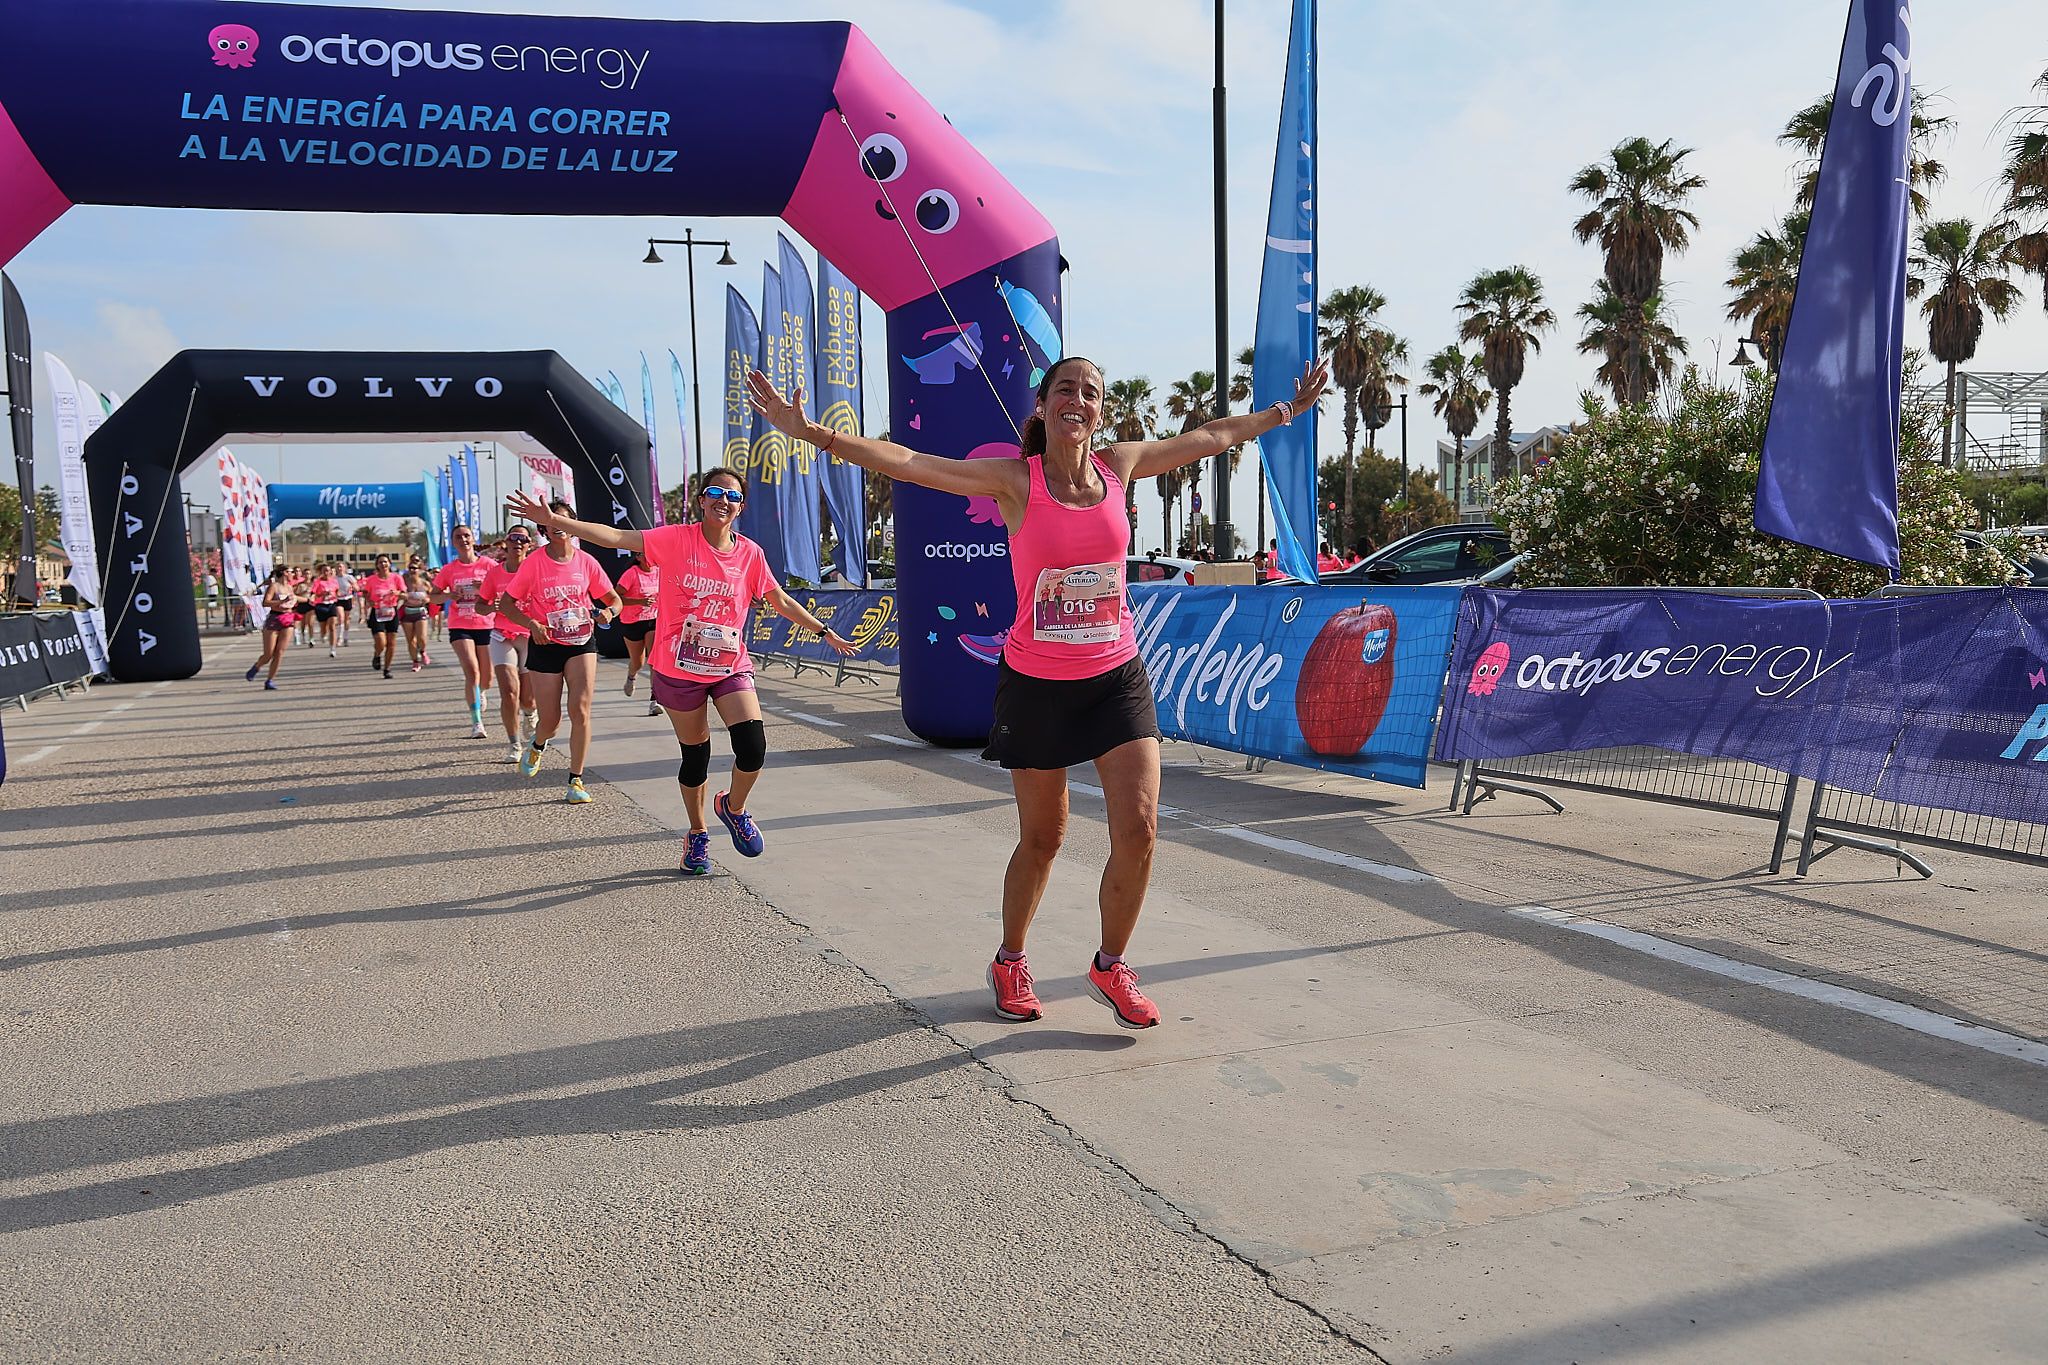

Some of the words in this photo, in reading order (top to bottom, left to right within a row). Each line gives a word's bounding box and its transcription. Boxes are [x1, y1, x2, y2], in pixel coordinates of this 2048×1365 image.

[279, 33, 485, 78] octopus
[490, 44, 651, 90] energy
[180, 92, 230, 121] LA
[241, 94, 408, 129] ENERGÍA
[418, 103, 518, 133] PARA
[528, 107, 671, 137] CORRER
[178, 134, 207, 160] A
[218, 136, 267, 162] LA
[278, 138, 492, 170] VELOCIDAD
[500, 146, 549, 171] DE
[556, 148, 601, 172] LA
[610, 149, 678, 173] LUZ
[243, 376, 503, 398] VOLVO
[524, 456, 563, 476] COSM
[318, 486, 386, 514] Marlene
[121, 474, 158, 656] VOLVO
[924, 541, 1007, 563] octopus
[1063, 599, 1097, 614] 016
[698, 646, 720, 658] 016
[1516, 647, 1670, 697] octopus
[1665, 643, 1854, 699] energy
